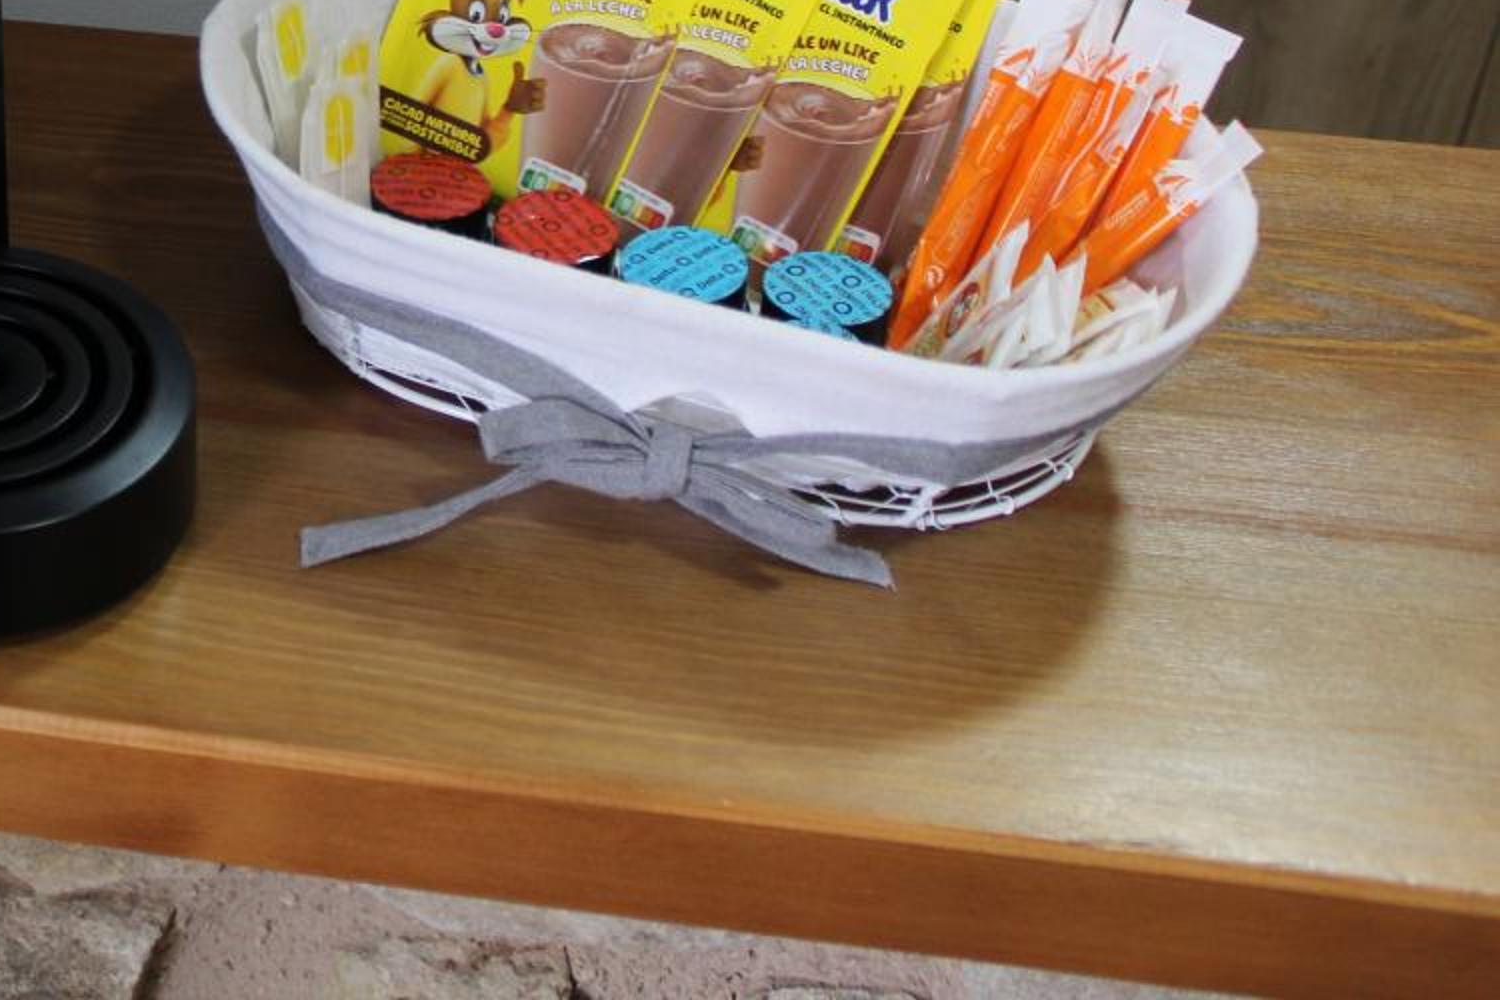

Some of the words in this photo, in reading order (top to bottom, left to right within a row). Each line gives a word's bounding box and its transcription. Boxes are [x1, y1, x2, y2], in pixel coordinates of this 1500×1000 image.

[700, 4, 722, 20] UN
[724, 10, 760, 35] LIKE
[819, 37, 841, 51] UN
[843, 41, 881, 65] LIKE
[383, 97, 425, 122] CACAO
[425, 115, 483, 149] NATURAL
